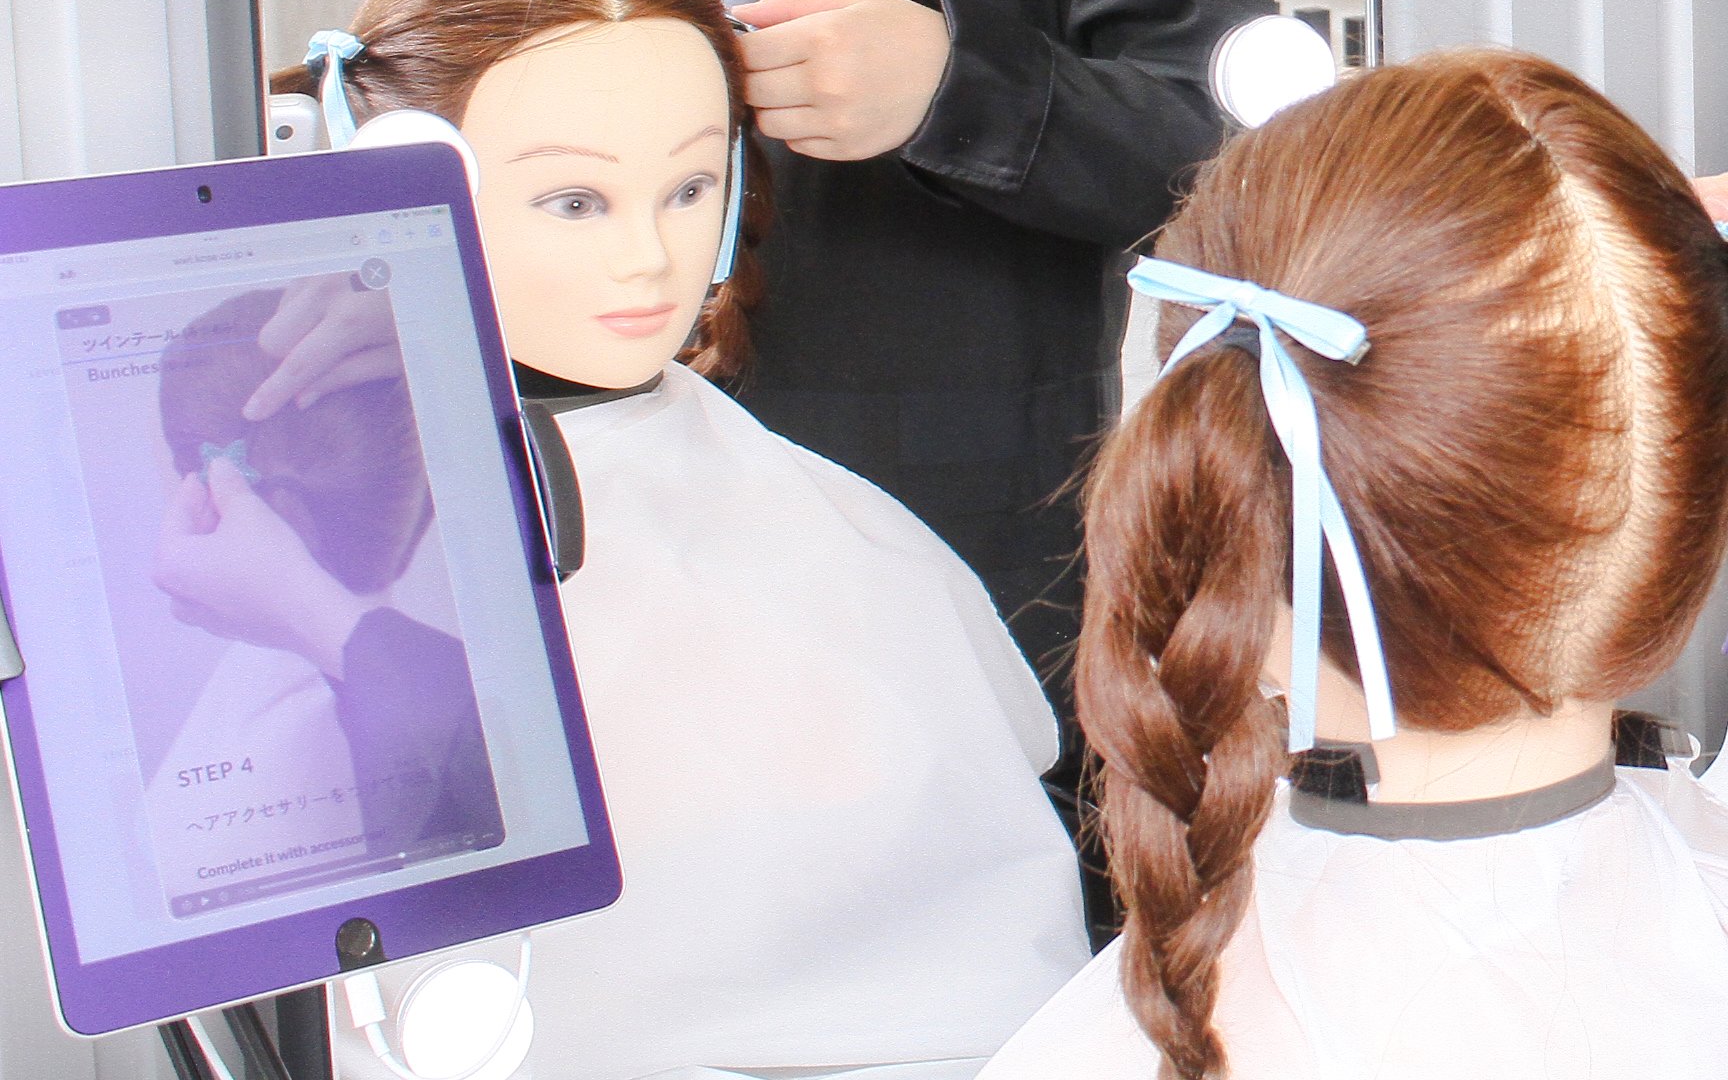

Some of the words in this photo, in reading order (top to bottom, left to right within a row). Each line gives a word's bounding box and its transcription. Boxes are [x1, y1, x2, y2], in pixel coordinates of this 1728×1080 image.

[88, 363, 159, 382] Bunches
[177, 761, 233, 788] STEP
[241, 757, 254, 773] 4
[197, 855, 263, 880] Complete
[264, 852, 275, 865] it
[277, 845, 308, 863] with
